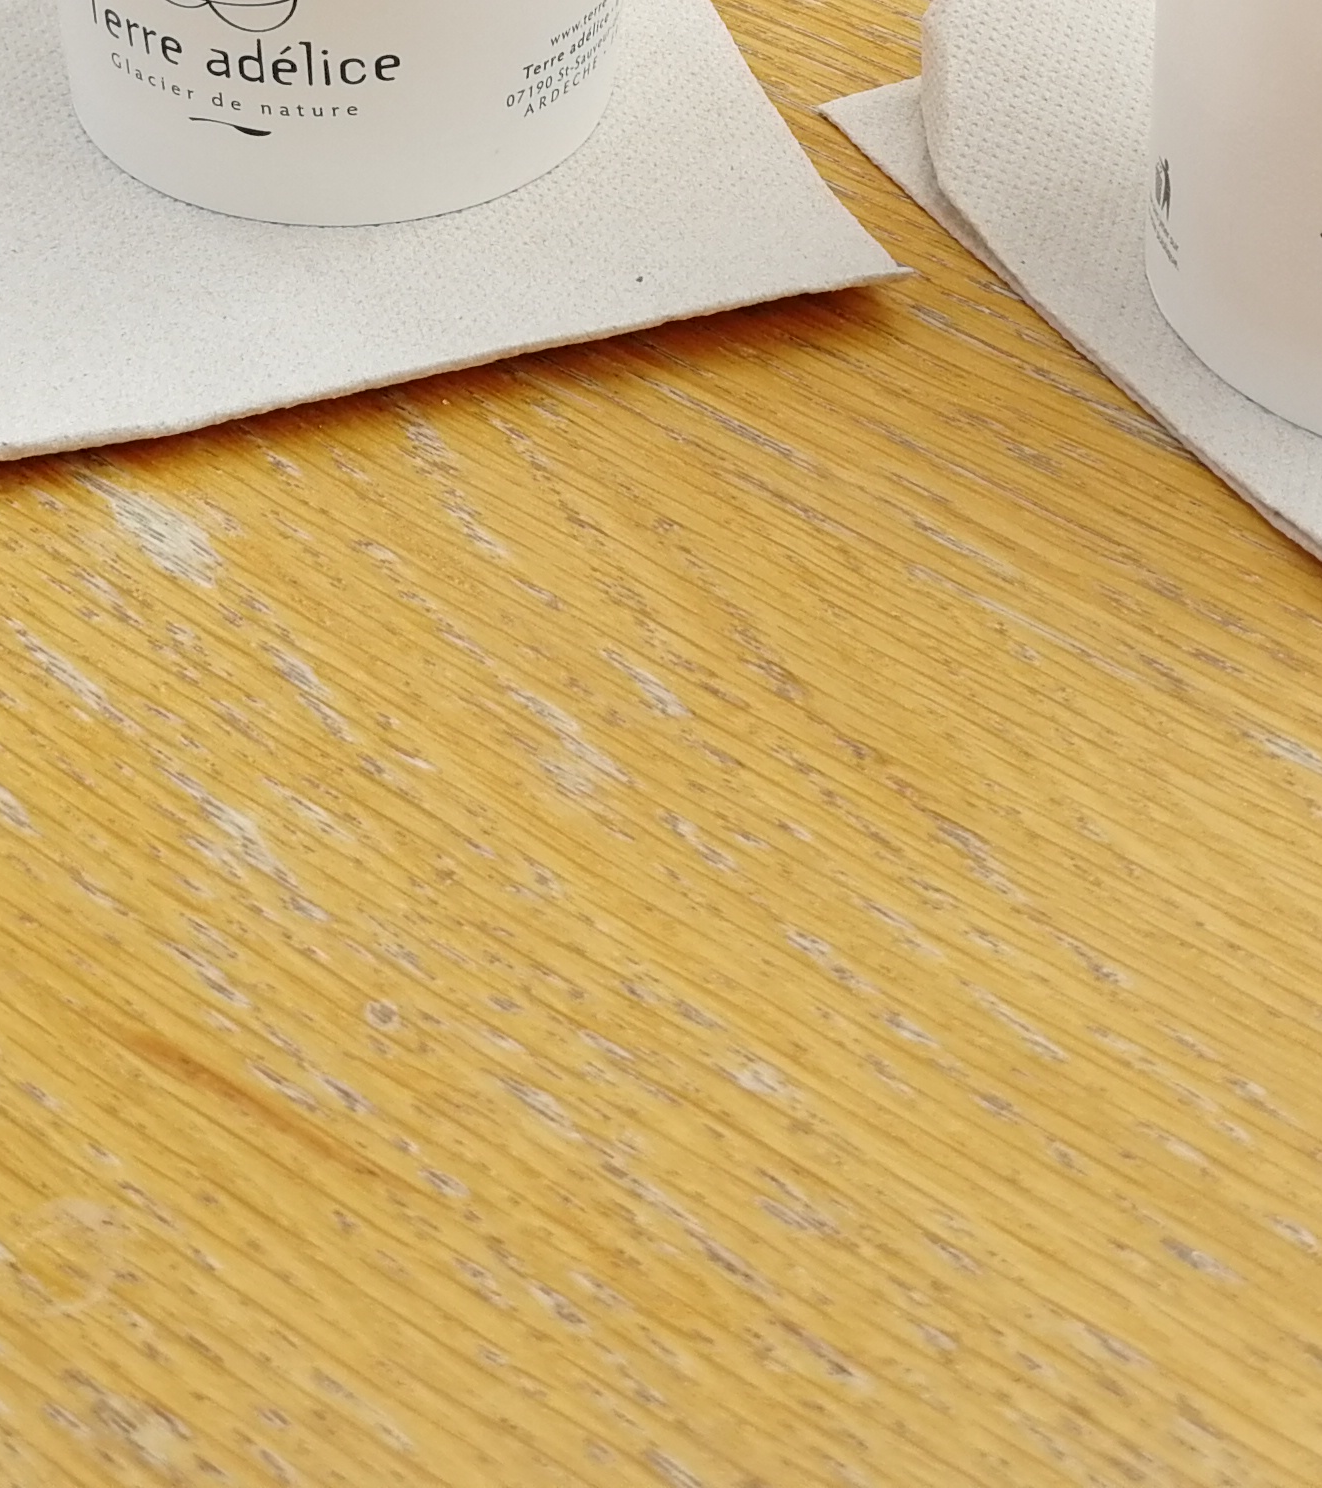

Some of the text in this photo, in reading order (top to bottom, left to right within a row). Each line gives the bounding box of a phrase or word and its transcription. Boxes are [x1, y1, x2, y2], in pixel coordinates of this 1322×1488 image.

[205, 38, 401, 87] adélice
[523, 51, 565, 80] Terre
[569, 12, 610, 55] adélice
[110, 52, 359, 118] Glacier de nature
[506, 75, 554, 108] 07190
[523, 55, 598, 118] ARDECHE
